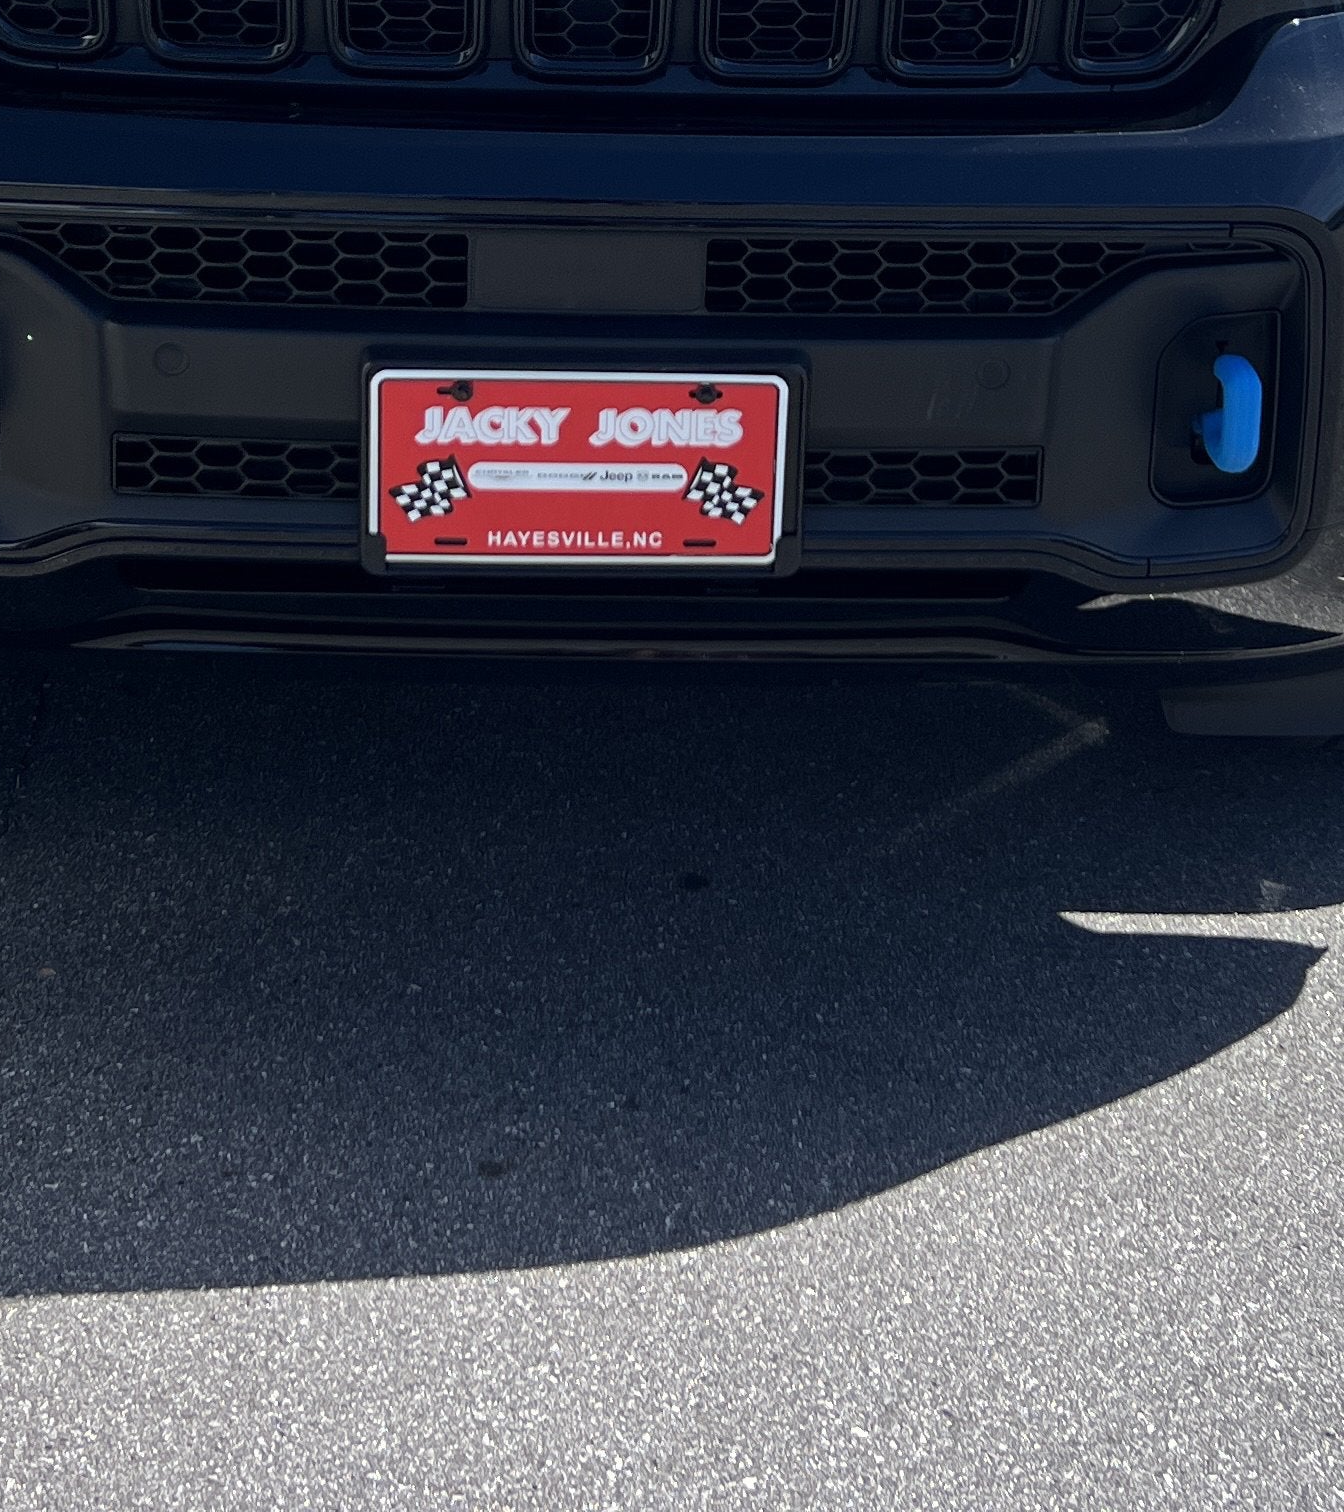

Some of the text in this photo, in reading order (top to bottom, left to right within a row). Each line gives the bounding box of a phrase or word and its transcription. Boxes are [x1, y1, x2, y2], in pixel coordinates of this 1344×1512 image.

[415, 406, 743, 448] JACKY JONES
[599, 468, 634, 483] Jeep
